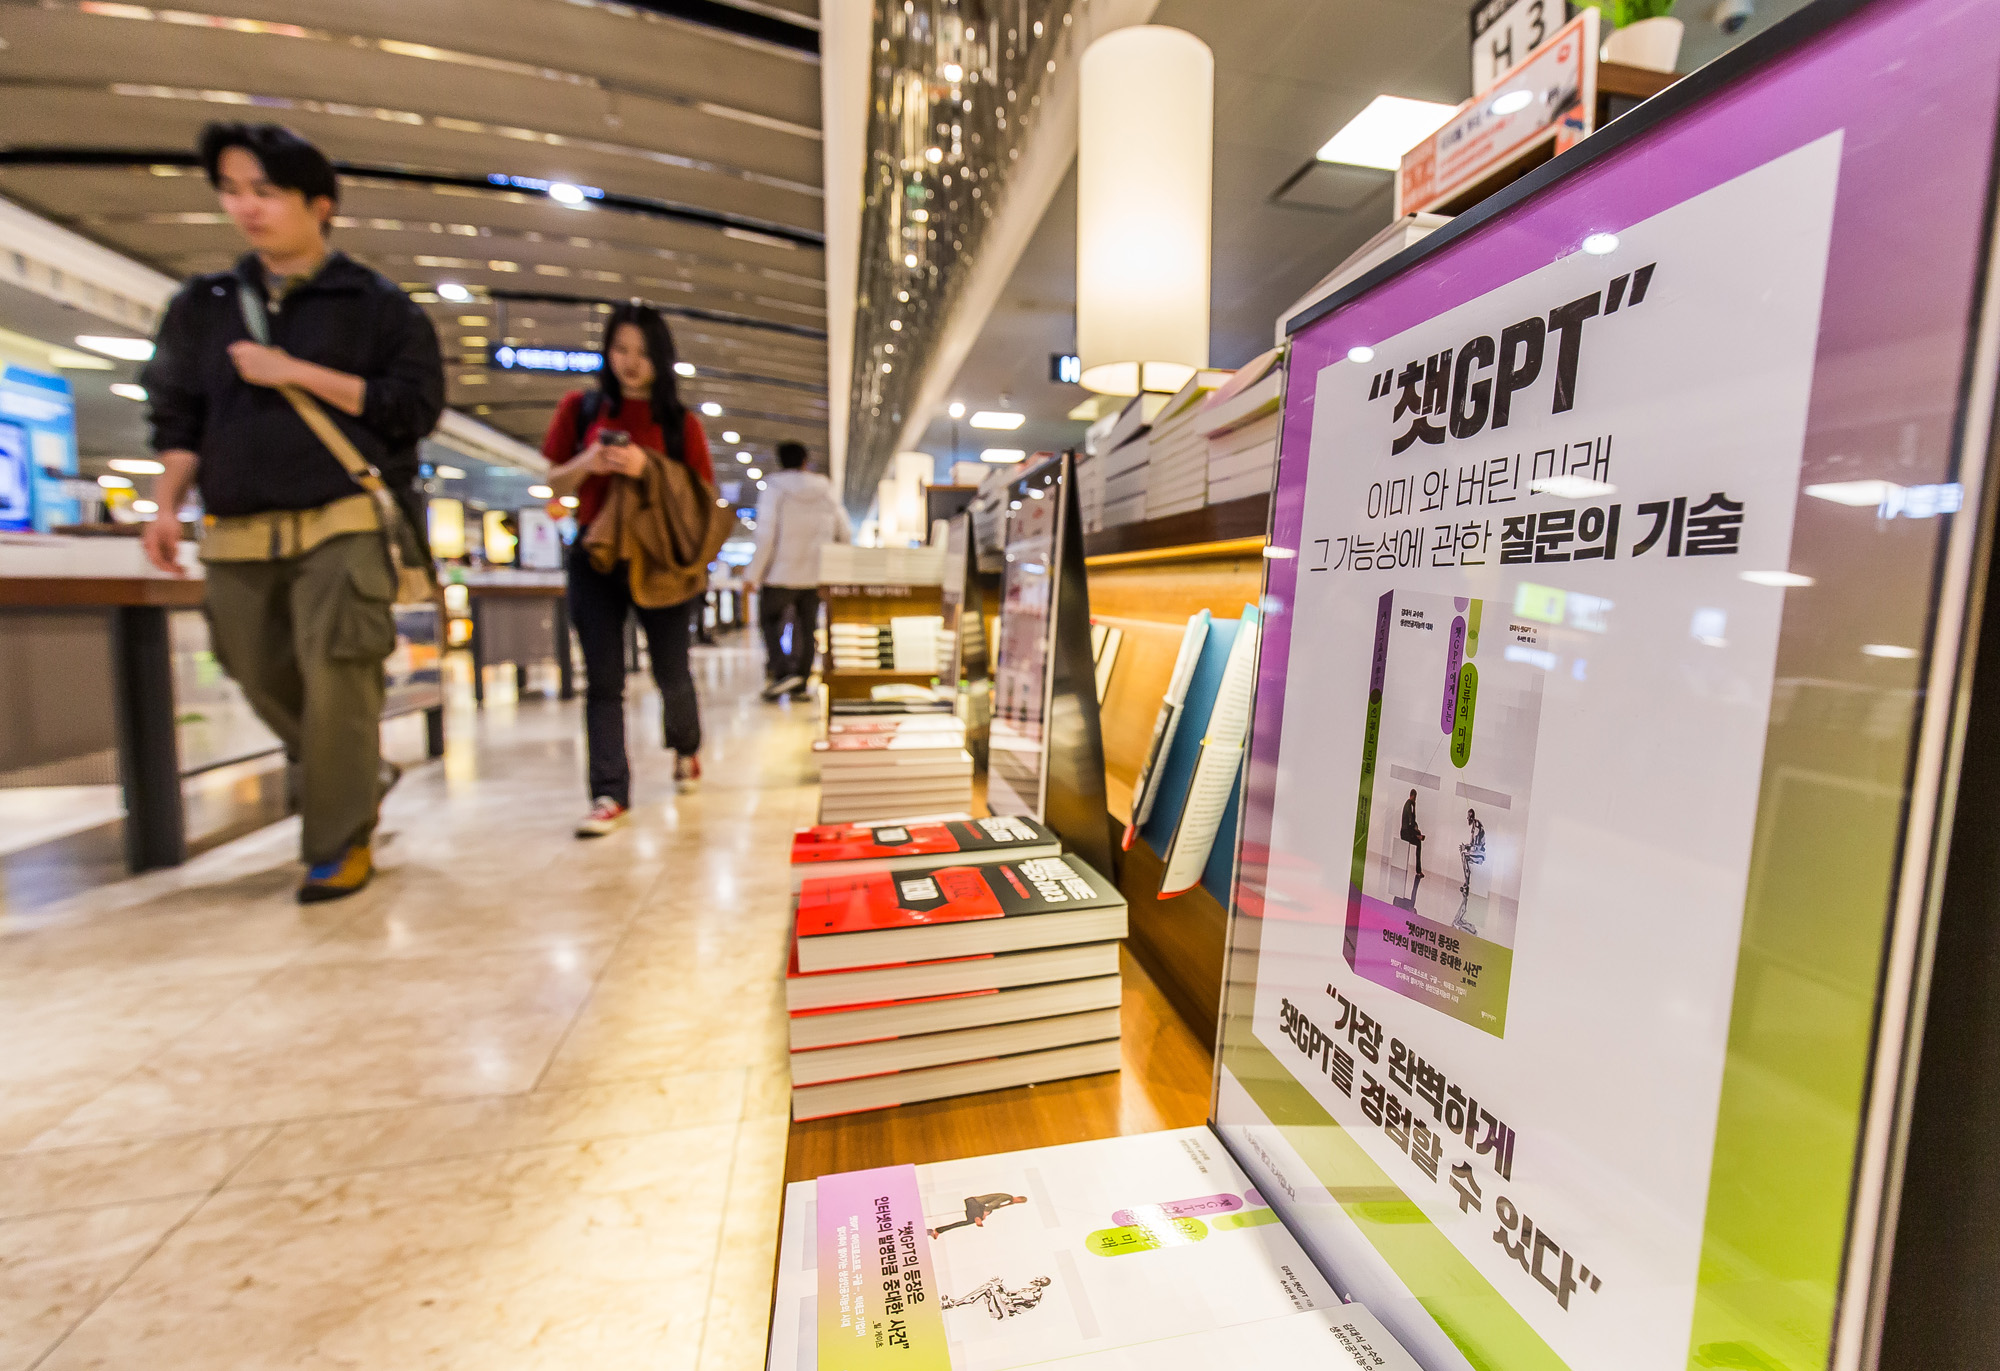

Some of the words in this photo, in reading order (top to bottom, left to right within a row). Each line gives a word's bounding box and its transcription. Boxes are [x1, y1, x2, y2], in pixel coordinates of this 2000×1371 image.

[1368, 261, 1657, 456] “챗GPT”
[1367, 474, 1414, 519] 이미
[1419, 471, 1450, 513] 와
[1458, 452, 1521, 507] 버린
[1531, 434, 1613, 496] 미래
[1333, 525, 1424, 571] 가능성에
[1431, 519, 1492, 568] 관한
[1500, 503, 1622, 565] 질문의
[1631, 491, 1745, 558] 기술
[1449, 627, 1462, 696] 챗GPT에게
[1446, 699, 1455, 722] 묻는
[1460, 673, 1472, 721] 인류의
[1456, 726, 1467, 758] 미래
[1383, 929, 1409, 950] 인터넷의
[1411, 940, 1438, 962] 발명만큼
[1440, 951, 1462, 971] 중대한
[1438, 934, 1460, 954] 등장은
[1326, 983, 1384, 1065] “가장
[1388, 1036, 1516, 1183] 완벽하게
[1279, 998, 1355, 1099] 챗GPT를
[1359, 1070, 1444, 1184] 경험할
[1449, 1160, 1482, 1215] 수
[1492, 1195, 1604, 1313] 있다”
[874, 1196, 893, 1233] 인터넷의
[878, 1234, 898, 1276] 발명만큼
[898, 1221, 919, 1267] “챗GPT의
[1100, 1233, 1137, 1249] 미래
[839, 1270, 850, 1313] 생성인공지능의
[883, 1279, 904, 1315] 중대한
[904, 1269, 925, 1304] 등장은
[841, 1314, 851, 1328] 시대
[855, 1316, 866, 1337] 기업이
[888, 1319, 909, 1349] 사건”
[1342, 1323, 1366, 1343] 김대식
[1361, 1344, 1385, 1365] 교수와
